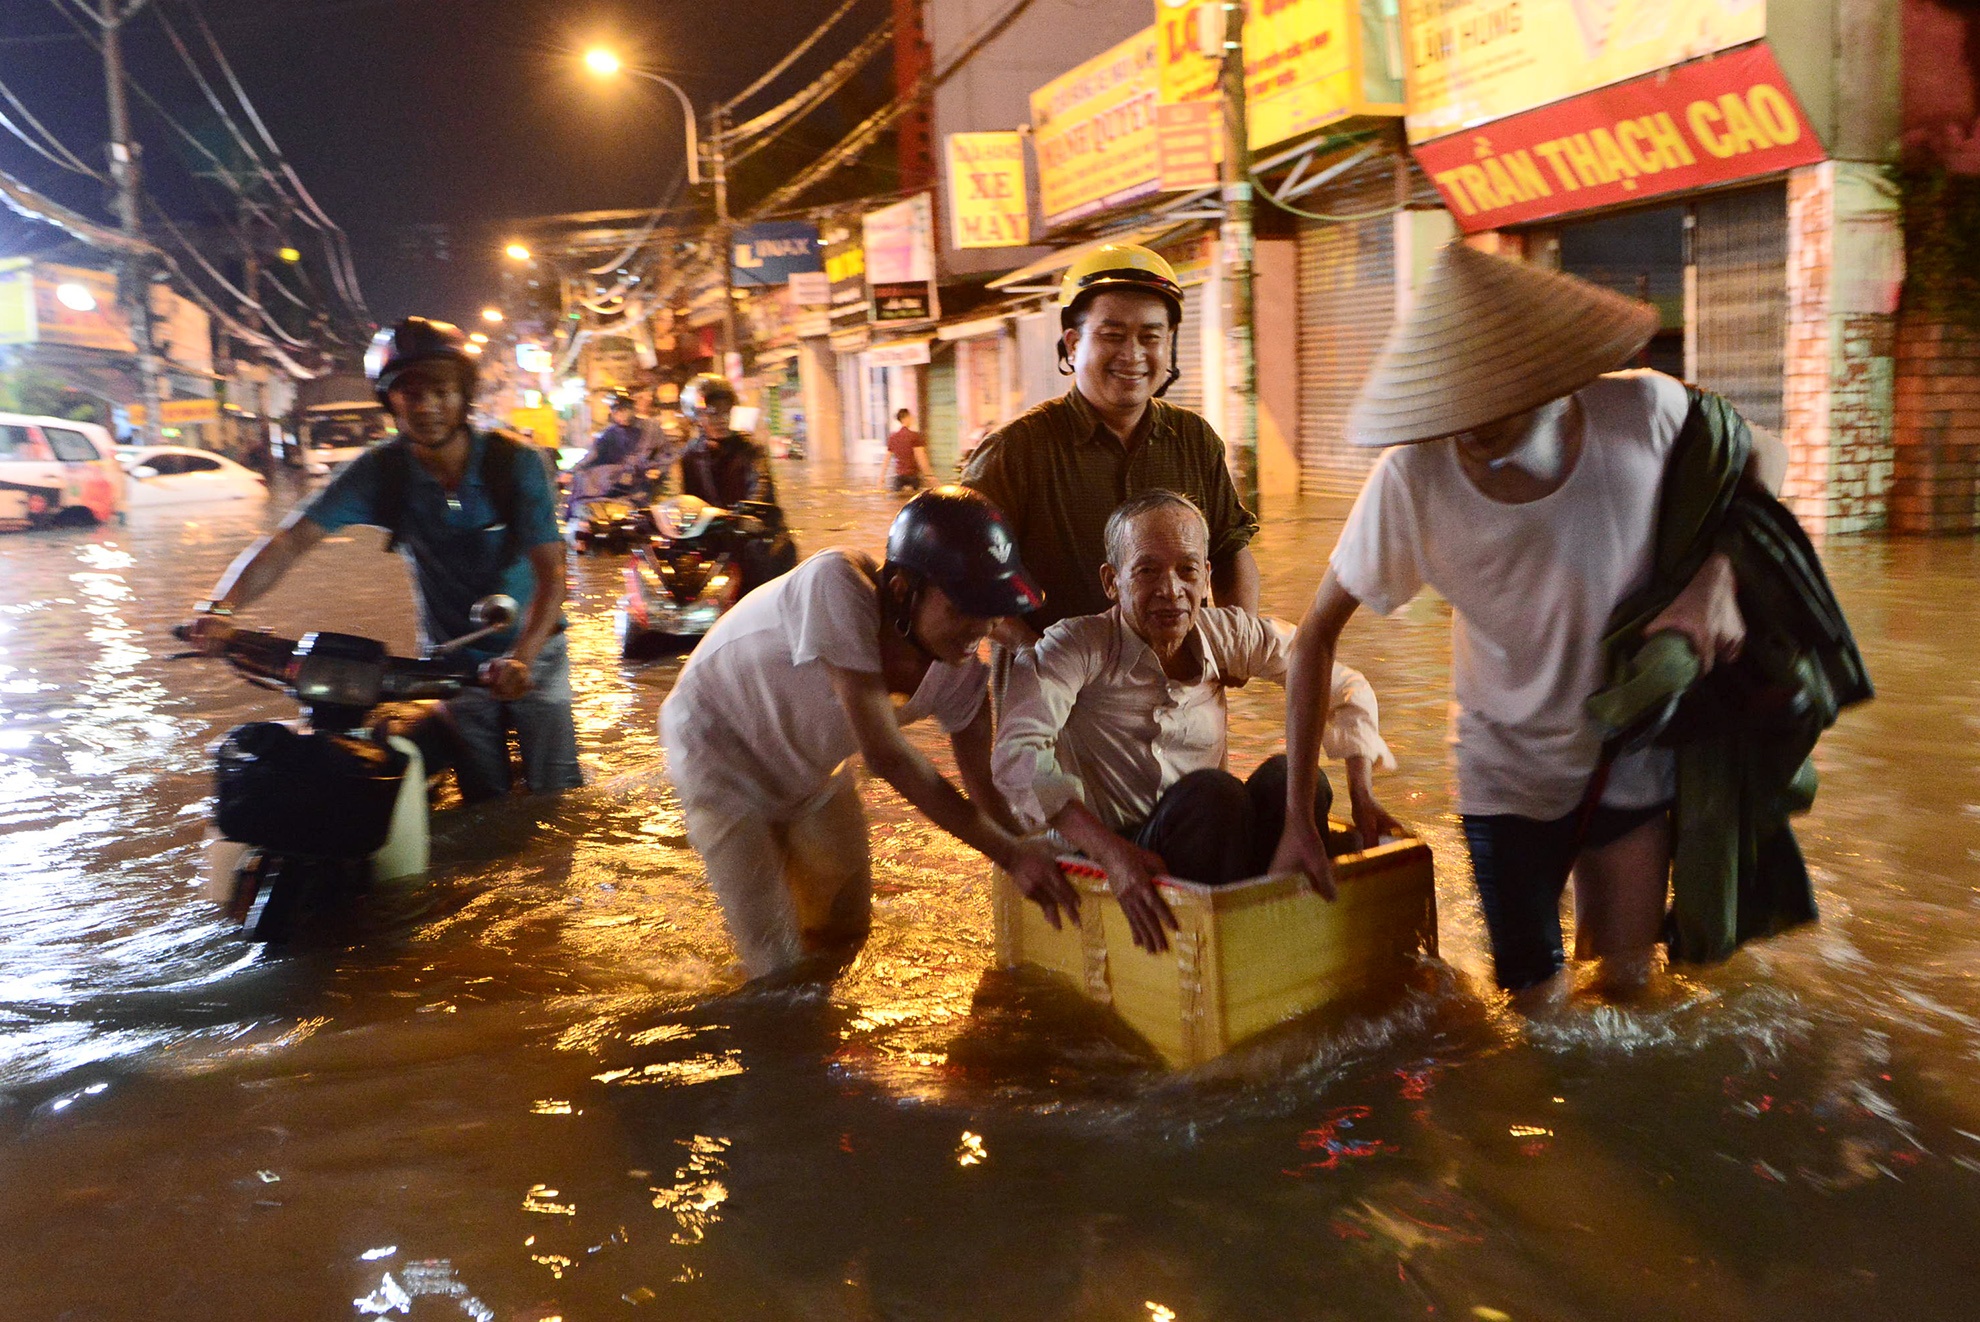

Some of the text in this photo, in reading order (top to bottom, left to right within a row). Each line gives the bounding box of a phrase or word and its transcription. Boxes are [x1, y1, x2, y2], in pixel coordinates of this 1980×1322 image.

[968, 171, 1014, 199] XE
[1435, 83, 1801, 216] TRẦN THẠCH CAO
